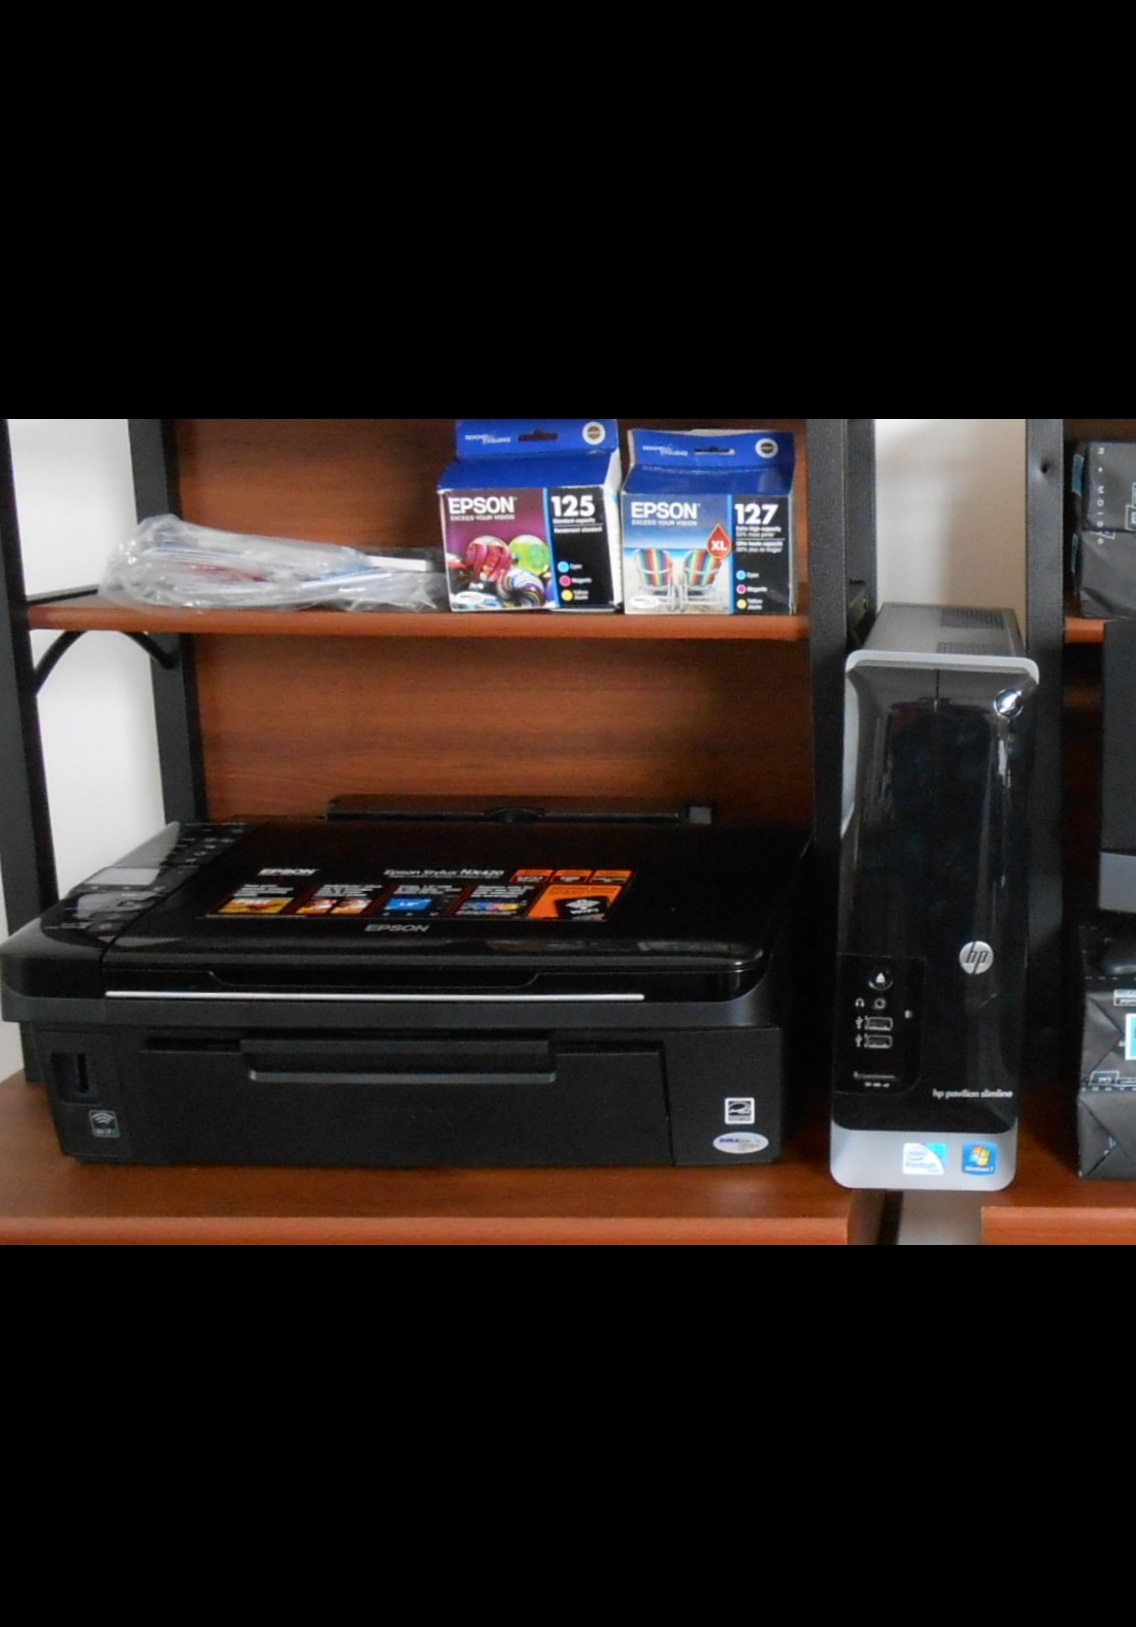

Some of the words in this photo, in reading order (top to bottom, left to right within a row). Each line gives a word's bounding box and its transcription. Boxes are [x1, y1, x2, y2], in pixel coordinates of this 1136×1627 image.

[448, 496, 514, 514] EPSON
[551, 495, 596, 518] 125
[630, 502, 698, 520] EPSON
[734, 504, 778, 525] 127
[711, 540, 728, 552] XL
[258, 868, 316, 876] EPSON
[364, 924, 430, 932] EPSON
[932, 1088, 944, 1099] hp
[945, 1089, 979, 1099] pavilion
[980, 1088, 1013, 1098] slimline
